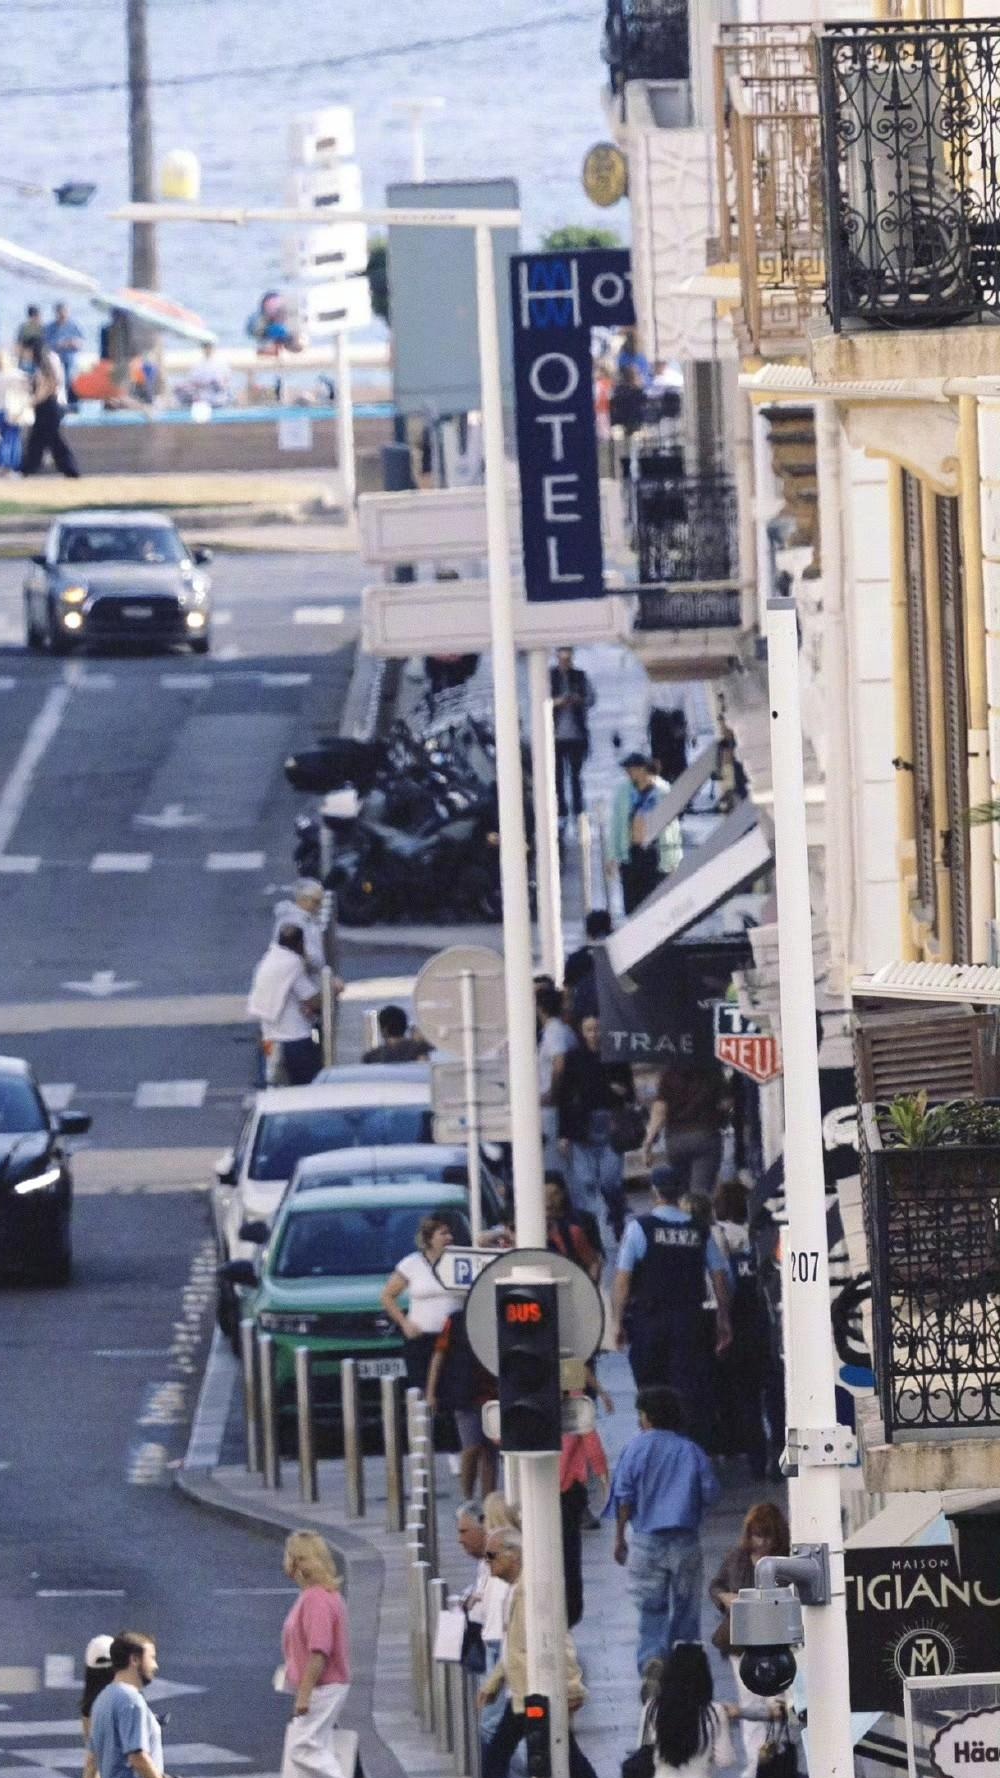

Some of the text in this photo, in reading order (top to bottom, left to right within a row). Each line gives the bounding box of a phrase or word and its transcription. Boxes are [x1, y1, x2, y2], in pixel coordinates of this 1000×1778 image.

[518, 258, 585, 584] HOTEL
[507, 1303, 541, 1322] BUS
[891, 1558, 950, 1570] MAISON
